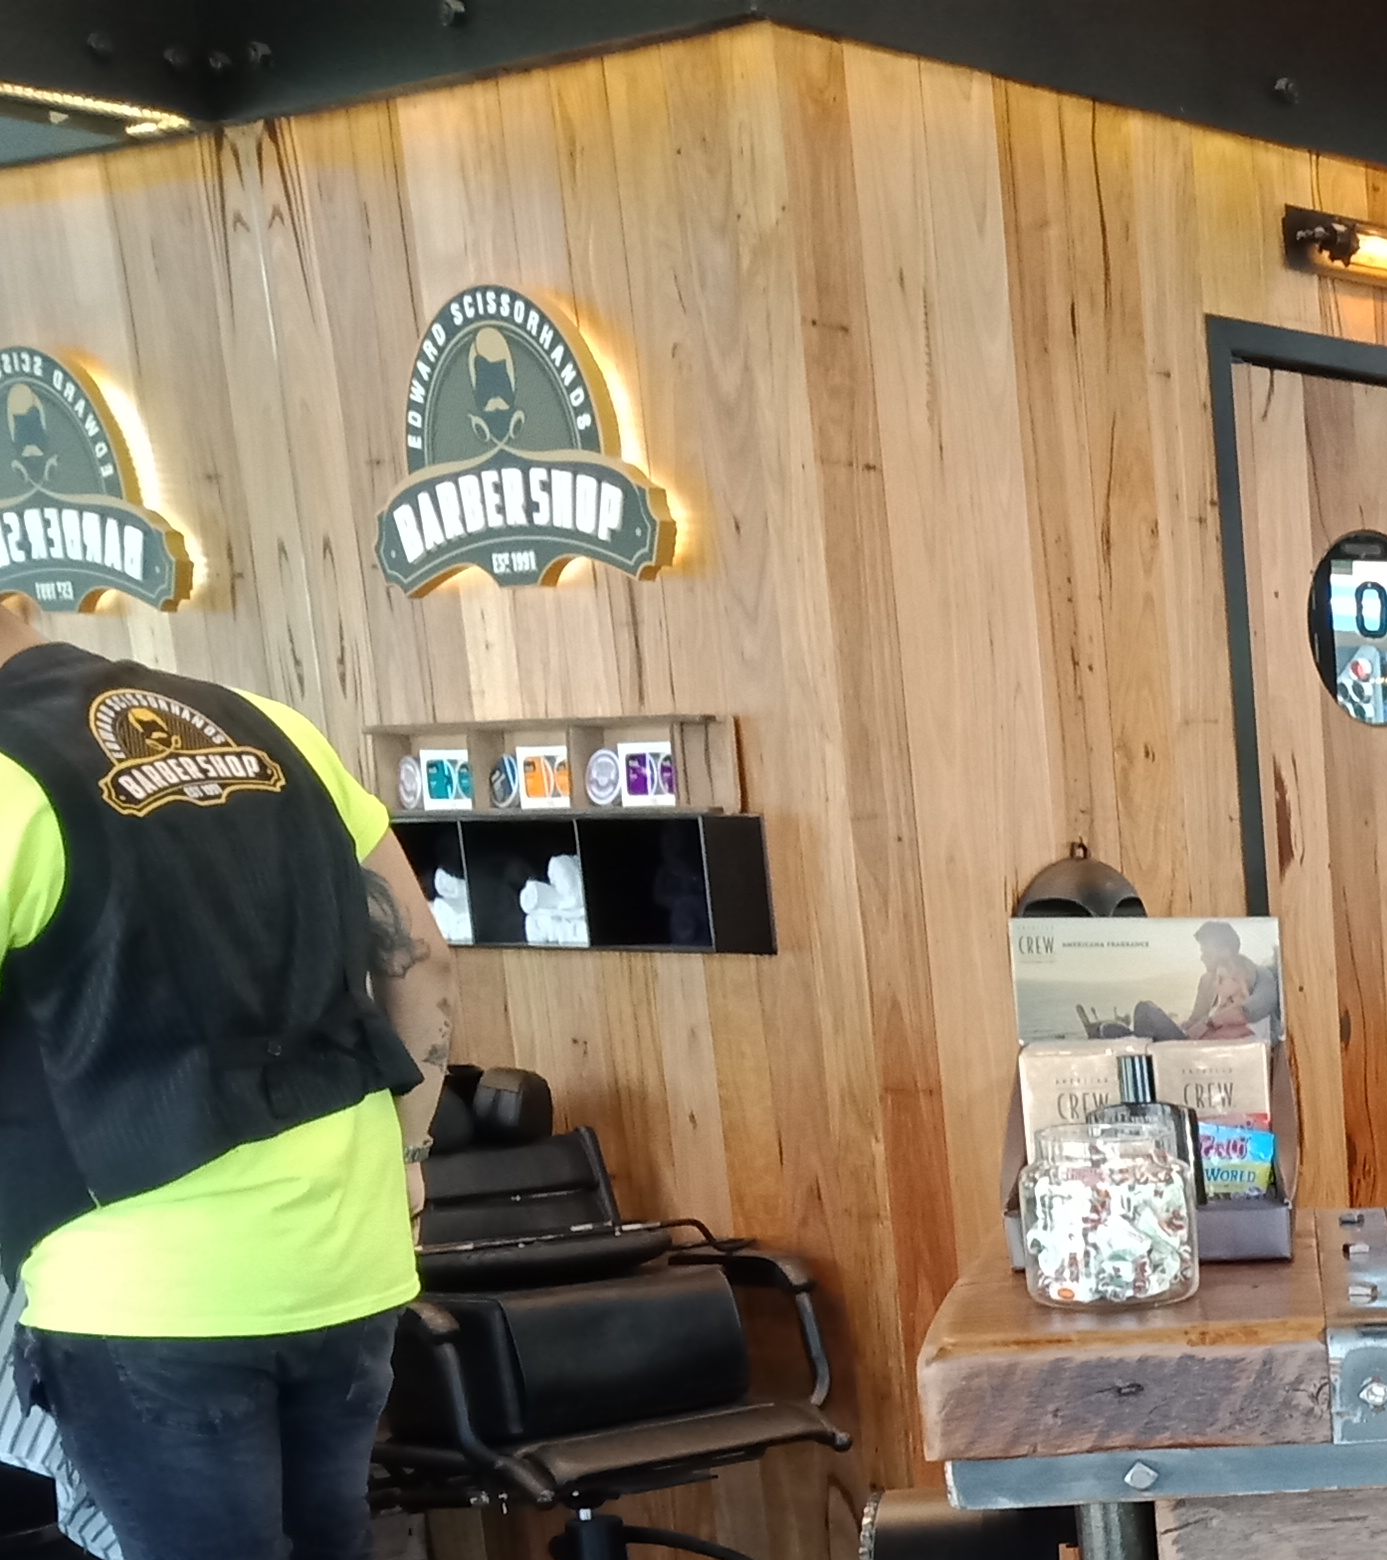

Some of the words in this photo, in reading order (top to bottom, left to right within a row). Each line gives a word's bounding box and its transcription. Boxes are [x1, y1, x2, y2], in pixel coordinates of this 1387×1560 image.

[407, 323, 447, 449] EDWARD
[449, 290, 592, 430] SCISSORHANDS
[393, 466, 624, 564] BARBERSHOP
[117, 753, 261, 800] BARBERSHOP
[1018, 935, 1055, 955] CREW
[1056, 1091, 1110, 1121] CREW
[1183, 1082, 1235, 1109] CREW
[1205, 1169, 1257, 1183] WORLD
